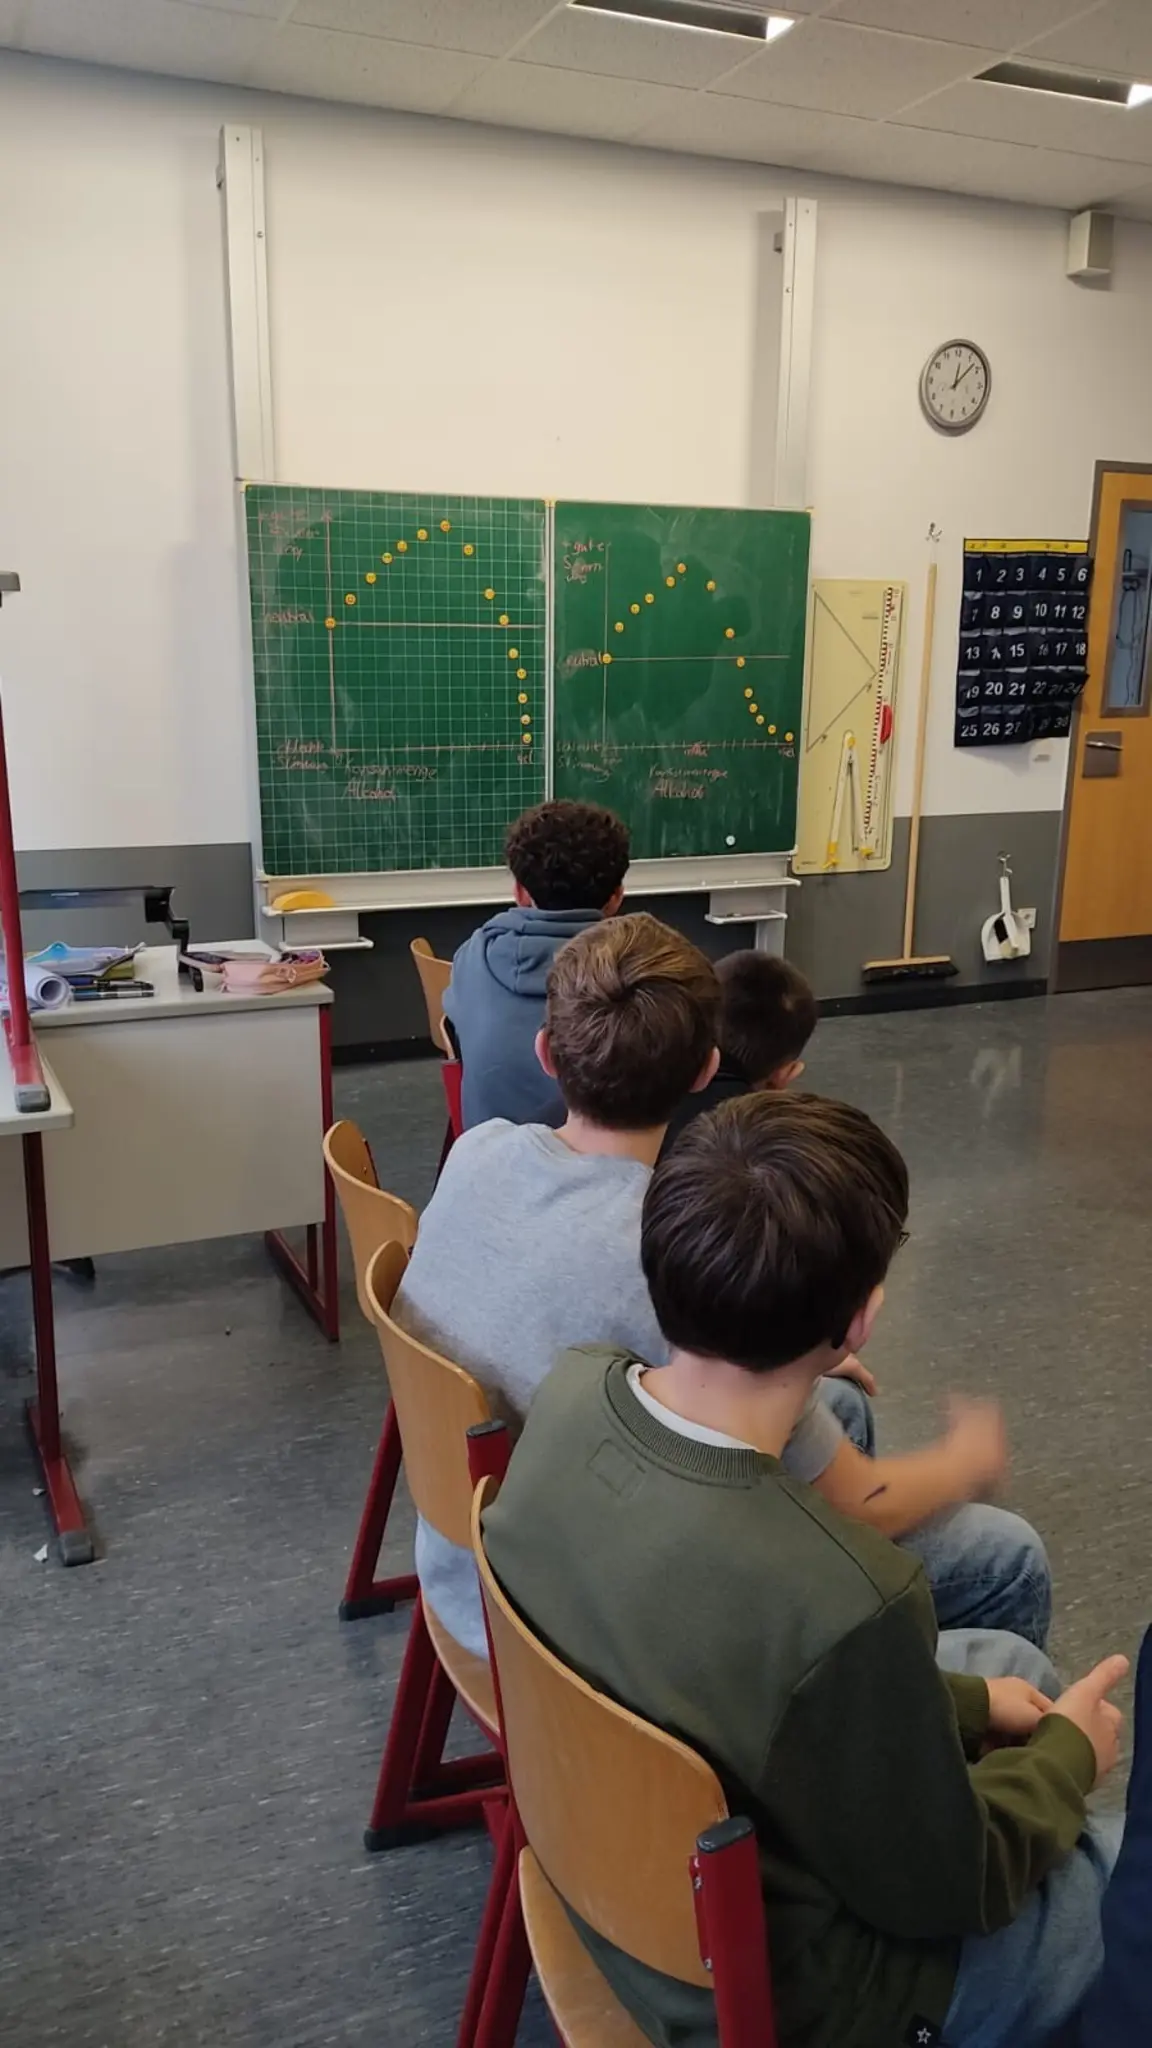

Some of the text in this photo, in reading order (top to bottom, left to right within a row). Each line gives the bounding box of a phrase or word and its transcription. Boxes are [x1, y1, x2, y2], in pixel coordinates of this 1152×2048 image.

[976, 567, 1088, 583] 1 2 3 4 5 6
[990, 606, 1001, 619] 8
[1012, 606, 1023, 619] 9
[1034, 603, 1048, 617] 10
[1054, 604, 1067, 618] 11
[1072, 606, 1086, 620] 12
[965, 646, 980, 660] 13
[1009, 643, 1025, 658] 15
[1055, 642, 1068, 655] 17
[1075, 643, 1086, 656] 18
[966, 685, 980, 699] 19
[984, 682, 1004, 696] 20
[1008, 682, 1026, 696] 21
[960, 724, 978, 738] 25
[982, 722, 1000, 736] 26
